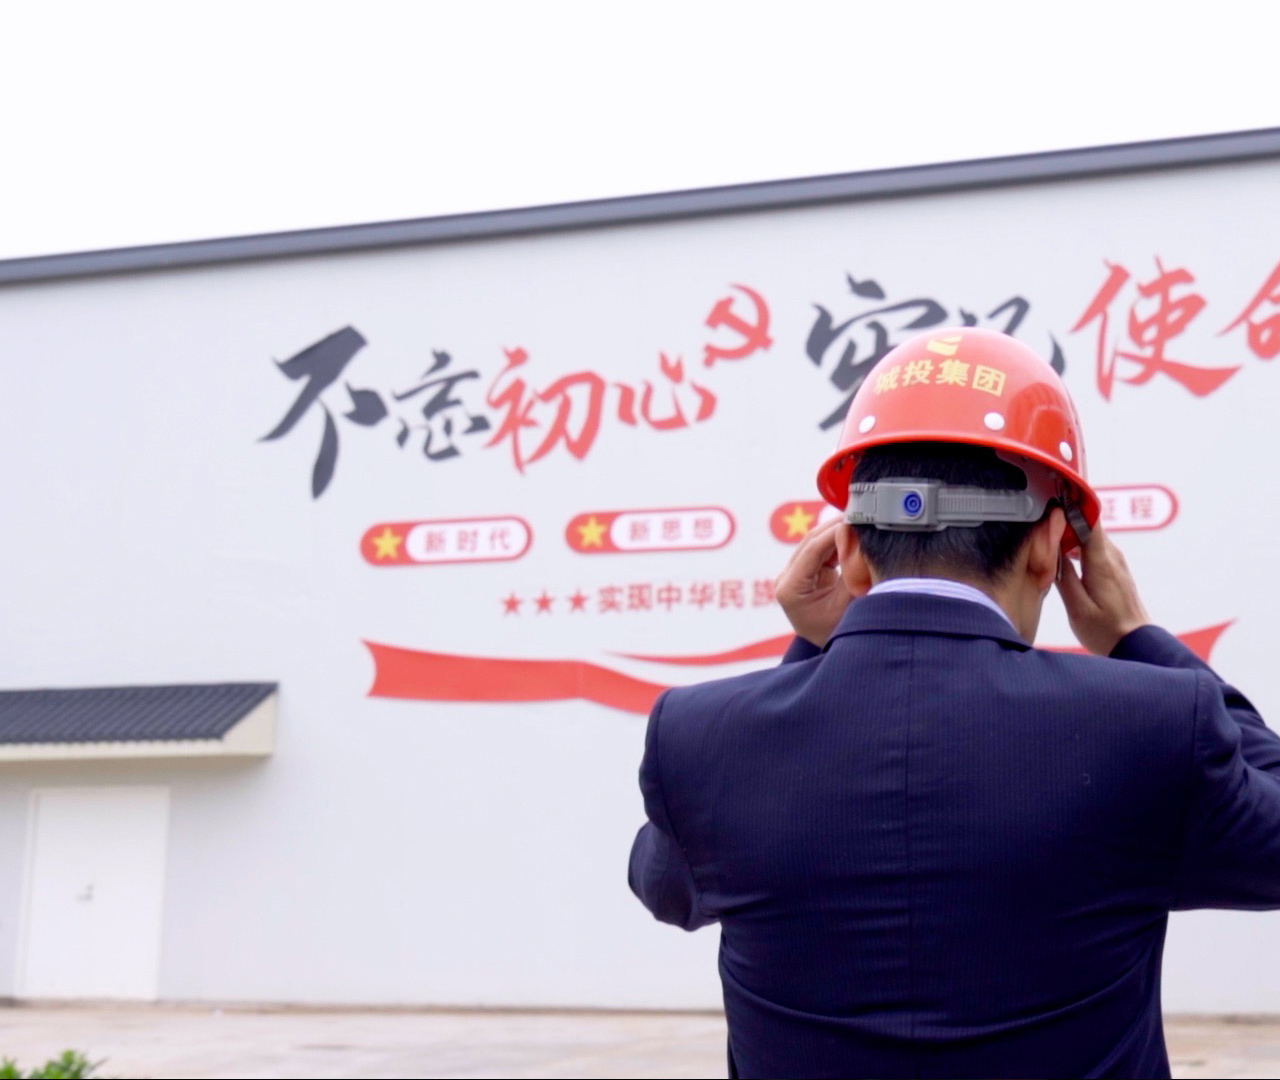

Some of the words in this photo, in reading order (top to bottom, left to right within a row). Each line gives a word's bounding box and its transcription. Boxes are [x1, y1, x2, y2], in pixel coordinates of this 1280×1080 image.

[873, 358, 1007, 397] 城投集团
[424, 527, 513, 554] 新时代
[628, 517, 715, 543] 新思想
